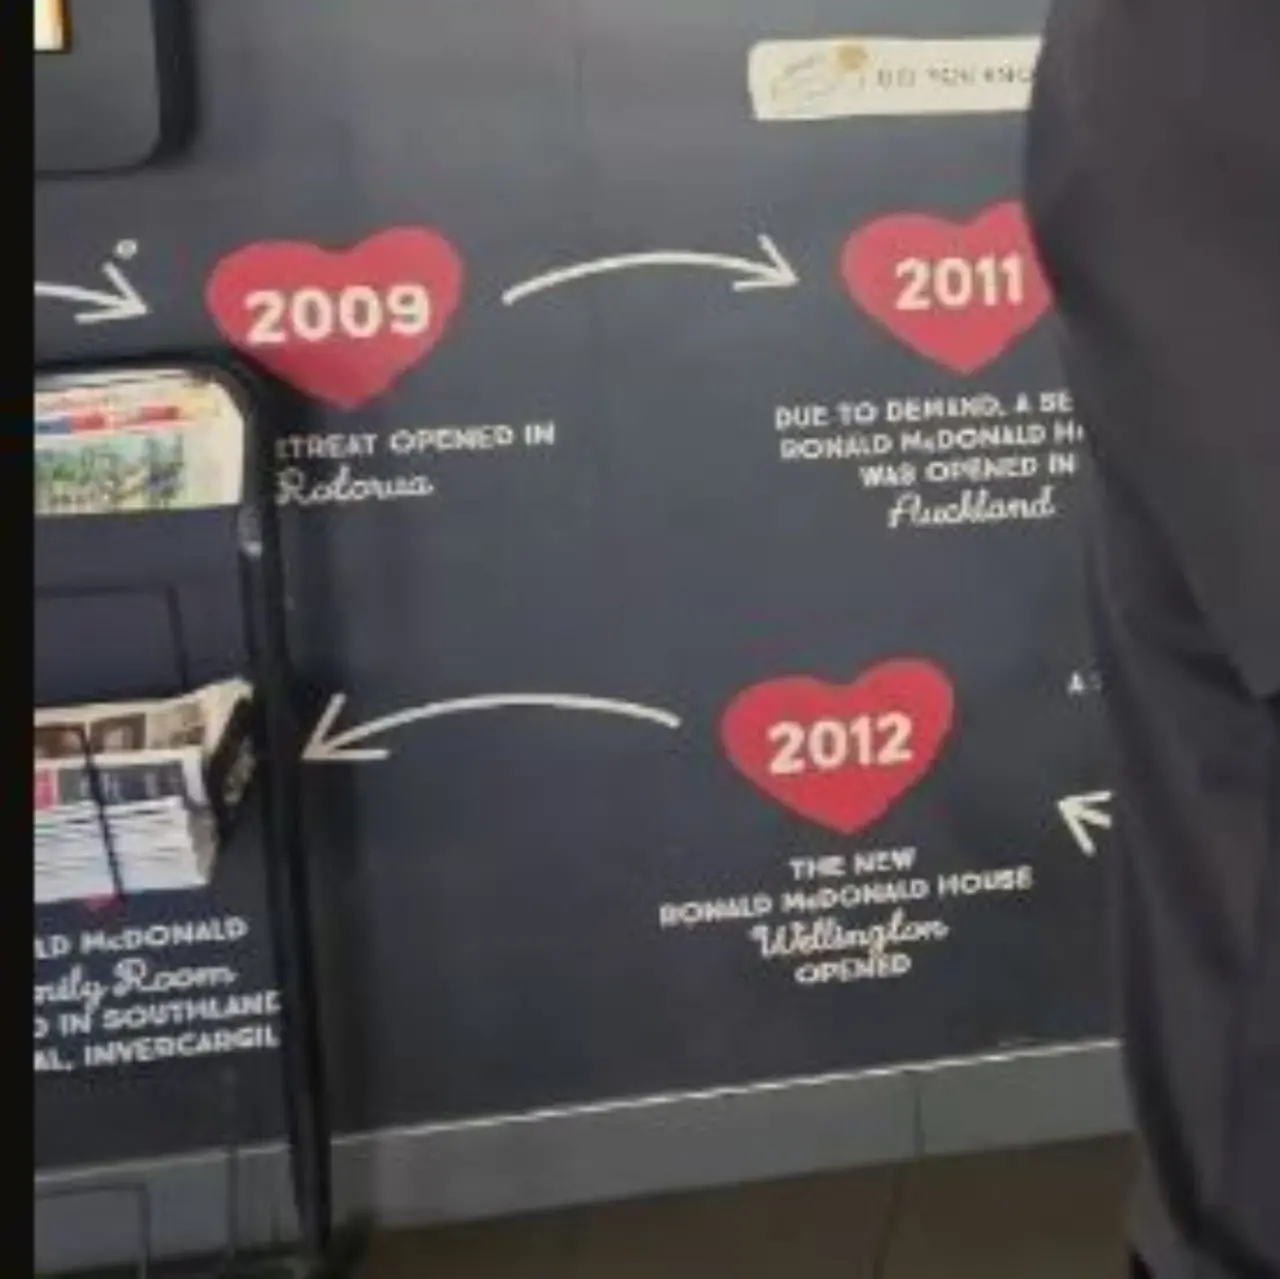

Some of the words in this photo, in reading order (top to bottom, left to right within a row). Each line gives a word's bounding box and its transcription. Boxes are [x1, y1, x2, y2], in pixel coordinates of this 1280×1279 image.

[893, 250, 1025, 312] 2011
[244, 283, 431, 346] 2009
[774, 404, 829, 431] DUE
[836, 400, 879, 425] TO
[390, 424, 515, 456] OPENED
[524, 421, 556, 446] IN
[779, 432, 894, 461] RONALD
[900, 423, 1047, 454] McDONALD
[858, 463, 917, 488] WAS
[924, 456, 1038, 483] OPENED
[1048, 452, 1076, 475] IN
[887, 484, 1056, 529] Auckland
[768, 711, 914, 776] 2012
[789, 855, 847, 881] THE
[854, 846, 918, 876] NEW
[659, 892, 774, 928] RONALD
[781, 878, 930, 913] McDONALD
[937, 865, 1034, 897] HOUSE
[79, 916, 249, 954] McDONALD
[747, 907, 950, 960] Wellington
[112, 957, 240, 998] Room
[794, 952, 913, 985] OPENED
[58, 1012, 92, 1037] IN
